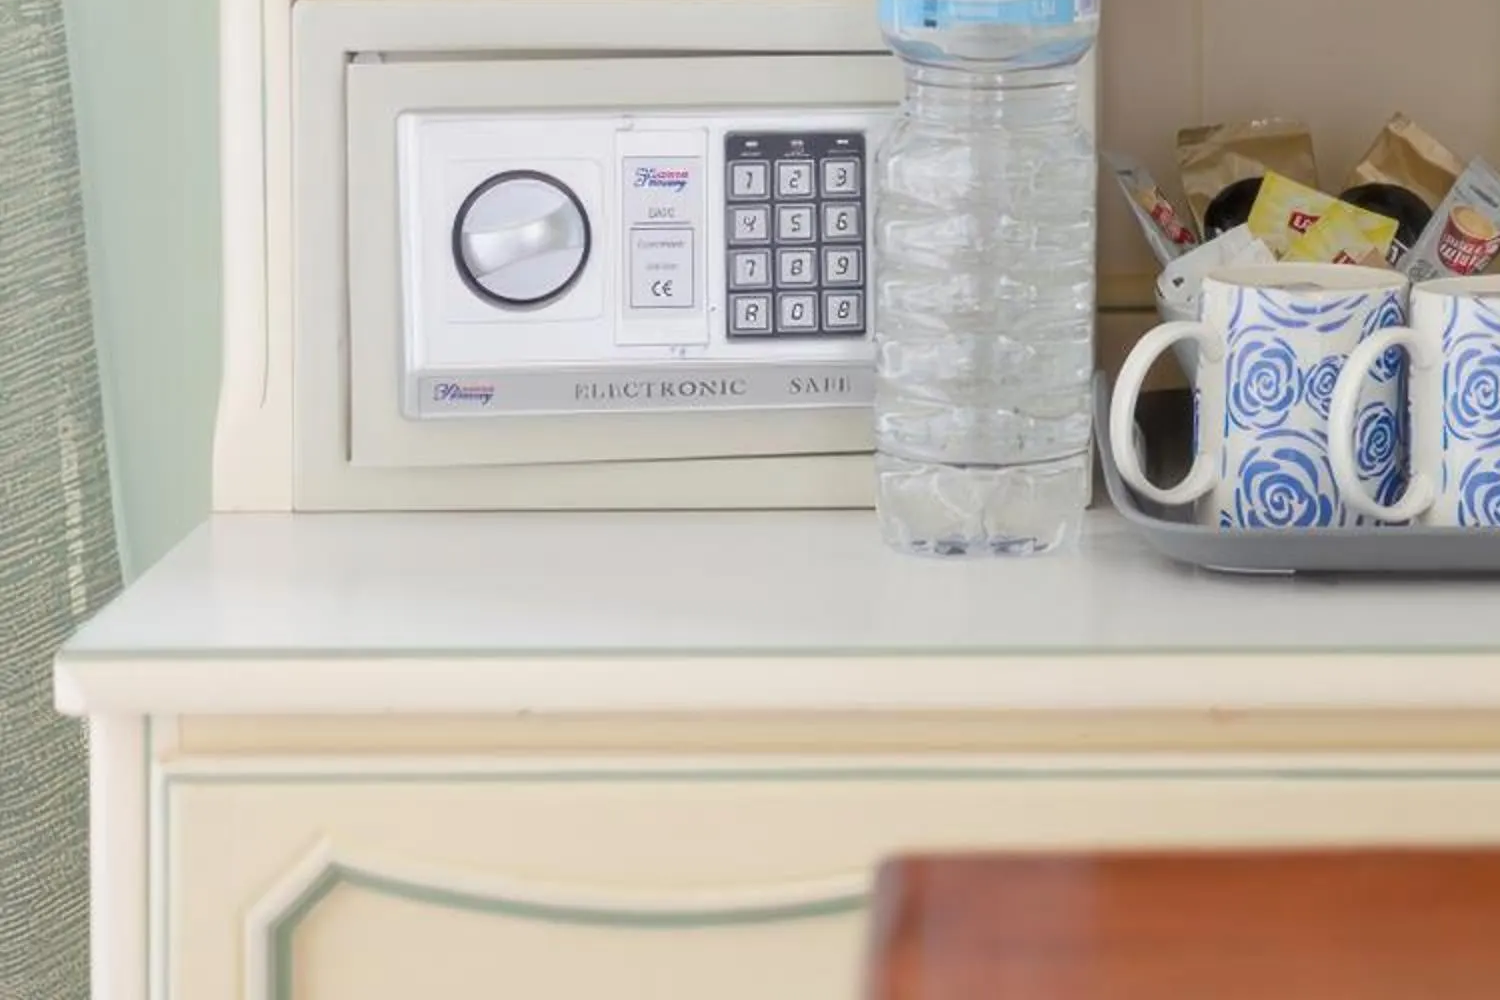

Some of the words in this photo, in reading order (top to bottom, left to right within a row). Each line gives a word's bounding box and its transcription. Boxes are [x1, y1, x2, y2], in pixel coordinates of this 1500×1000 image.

[788, 169, 802, 189] 2
[835, 167, 848, 187] 3
[743, 215, 757, 233] 4
[790, 213, 802, 232] 5
[835, 211, 849, 231] 6
[745, 258, 757, 277] 7
[790, 258, 804, 276] 8
[835, 256, 850, 275] 9
[574, 378, 748, 400] ELECTRONIC
[788, 375, 853, 395] SAFE
